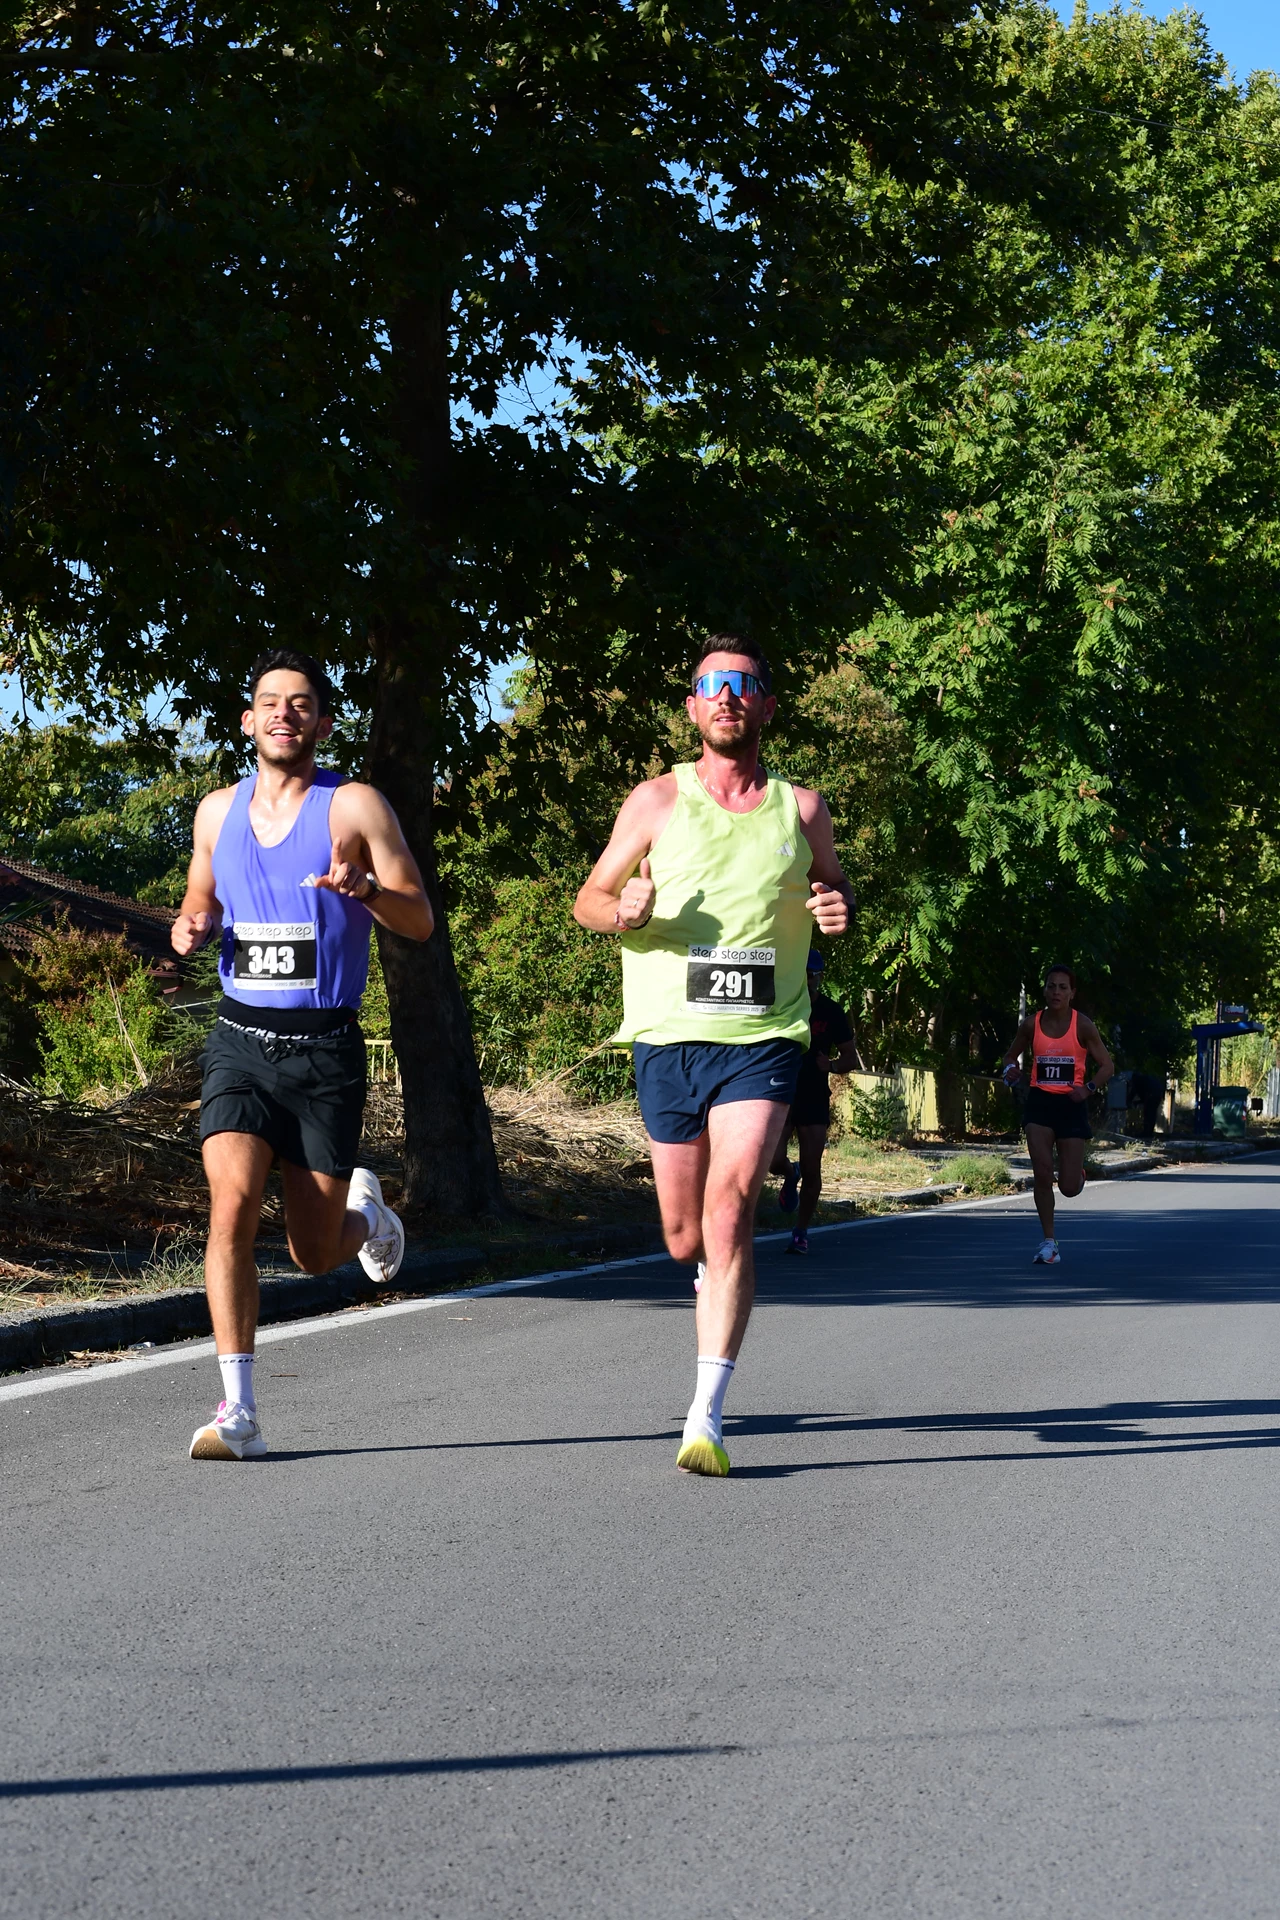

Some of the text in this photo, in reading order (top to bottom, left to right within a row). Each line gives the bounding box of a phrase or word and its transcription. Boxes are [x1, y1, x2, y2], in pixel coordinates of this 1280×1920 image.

[257, 925, 282, 939] step
[285, 925, 312, 939] step
[248, 945, 295, 974] 343
[691, 947, 773, 964] step step step
[709, 970, 753, 998] 291
[218, 1016, 350, 1040] OMPRERT
[1045, 1066, 1060, 1078] 171
